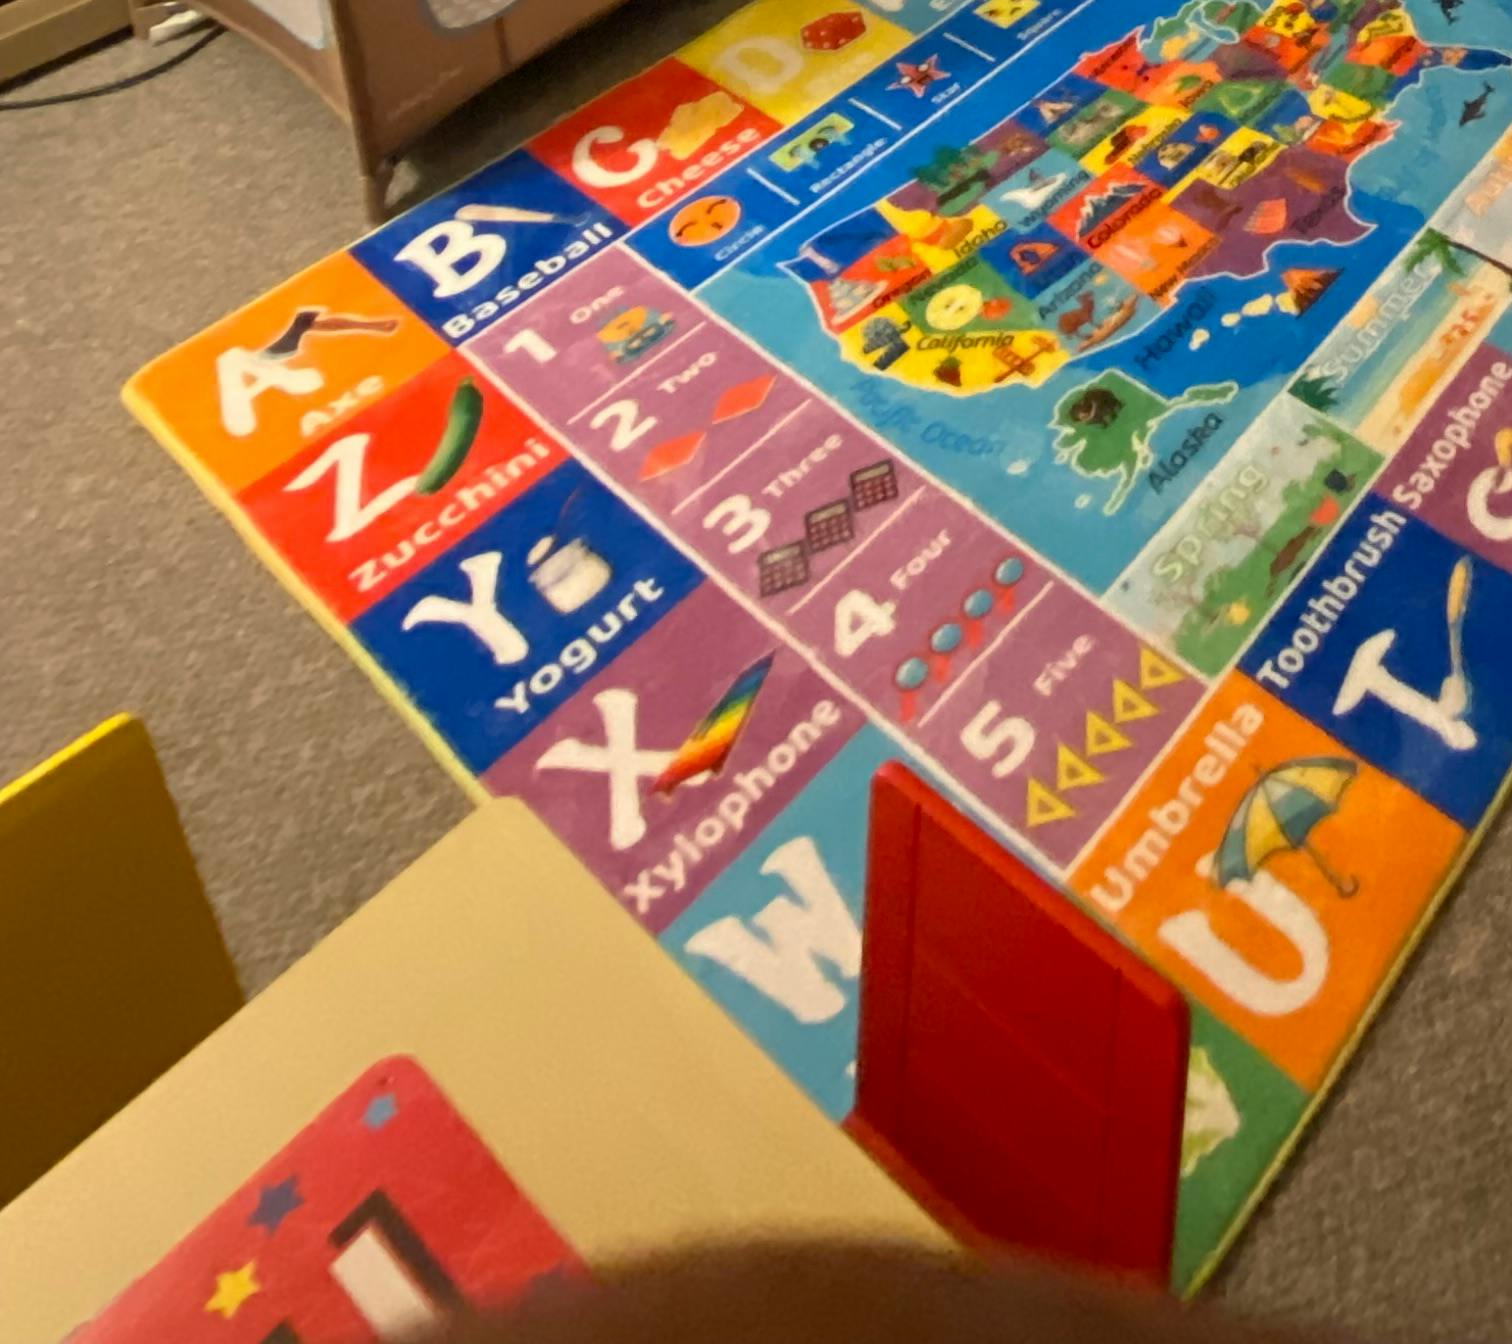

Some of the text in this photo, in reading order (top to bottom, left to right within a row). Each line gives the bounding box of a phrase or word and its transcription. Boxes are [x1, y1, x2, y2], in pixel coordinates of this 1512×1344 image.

[570, 125, 661, 189] C
[635, 127, 763, 210] Cheese
[808, 135, 890, 196] Rectangle
[713, 223, 766, 263] Circle
[953, 219, 1009, 260] Idaho
[1086, 187, 1163, 251] Colorado
[394, 218, 508, 299] B
[440, 221, 615, 339] Baseball
[1038, 262, 1104, 322] Arizona
[568, 283, 626, 326] One
[915, 329, 1016, 355] California
[1319, 255, 1444, 384] Summer
[502, 327, 559, 365] 1
[654, 349, 719, 397] Two
[214, 345, 326, 439] A
[300, 373, 386, 439] Axe
[589, 398, 659, 454] 2
[761, 431, 844, 500] Three
[919, 420, 1009, 456] Ocean
[1148, 411, 1226, 496] Alaska
[283, 432, 421, 545] Z
[347, 437, 553, 594] Zucchini
[701, 490, 773, 555] 3
[1152, 459, 1271, 584] Spring
[889, 525, 954, 593] Four
[400, 549, 531, 666] Y
[833, 588, 898, 659] 4
[1255, 508, 1409, 691] Toothbrush
[493, 576, 666, 717] Yogurt
[1031, 631, 1098, 698] Five
[1332, 627, 1479, 752] T
[535, 687, 713, 852] X
[959, 699, 1037, 780] 5
[1088, 701, 1267, 914] Umbrella
[683, 835, 864, 1026] W
[1156, 850, 1332, 1018] U
